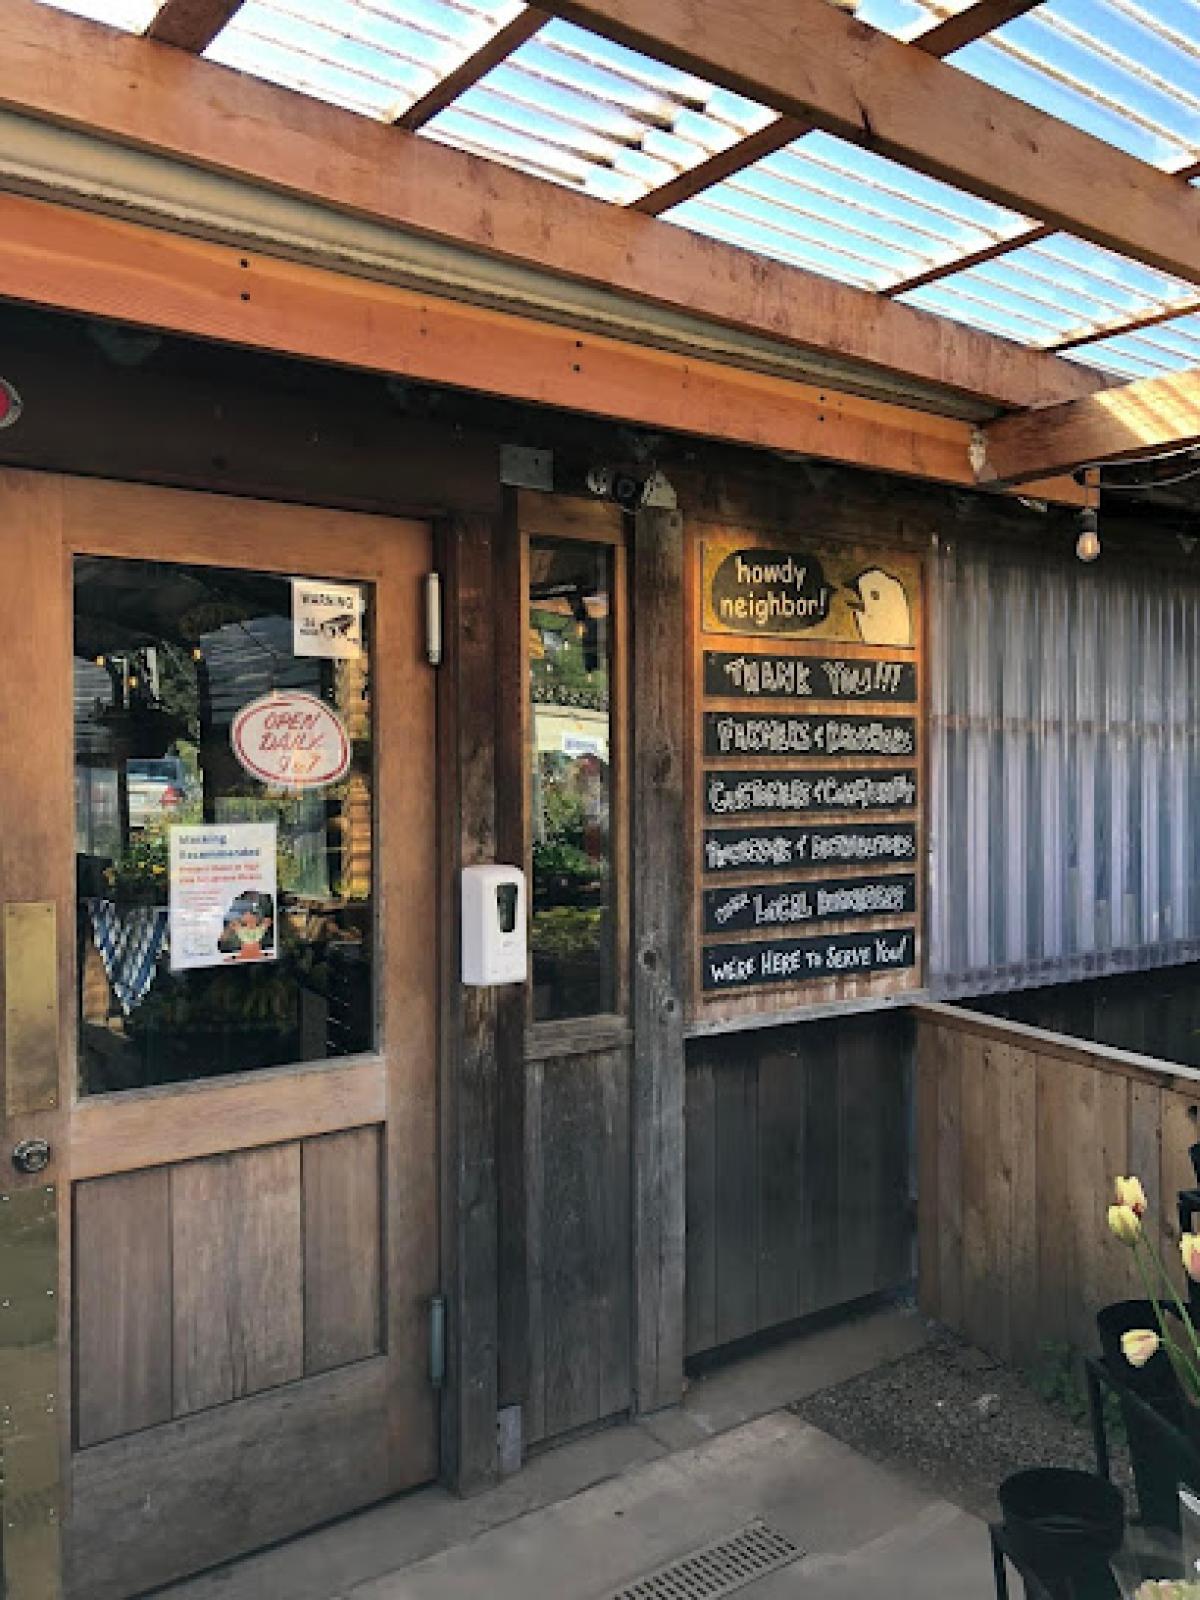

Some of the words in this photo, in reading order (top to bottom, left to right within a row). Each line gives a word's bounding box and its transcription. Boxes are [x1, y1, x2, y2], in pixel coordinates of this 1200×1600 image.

[735, 556, 806, 591] howdy
[720, 588, 827, 625] neighbor!
[723, 656, 812, 695] THANK
[264, 711, 321, 730] OPEN
[259, 732, 324, 751] DAILY
[753, 892, 813, 924] LOCAL
[760, 949, 801, 977] HERE
[826, 944, 871, 968] SERVE
